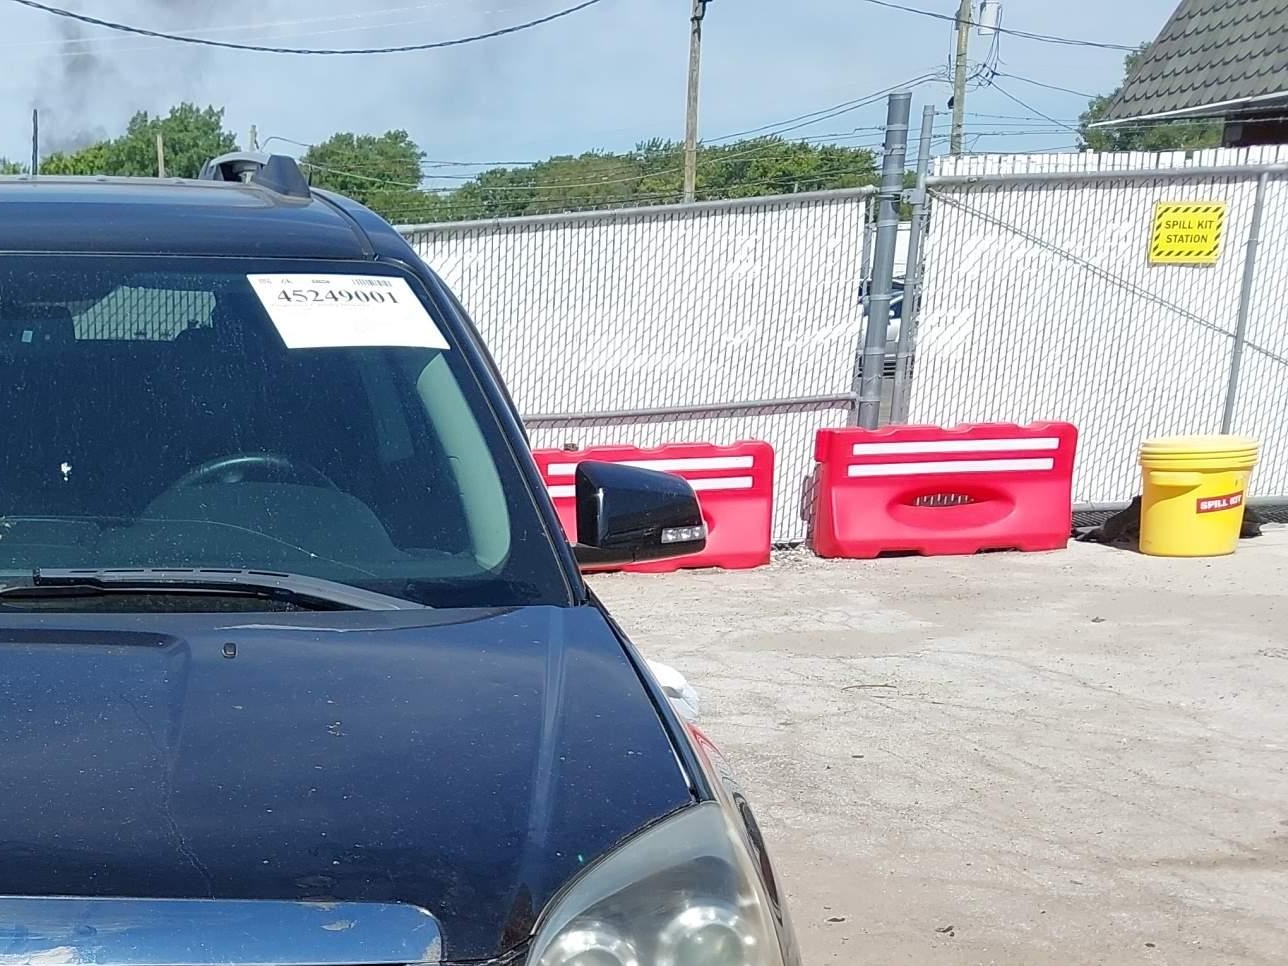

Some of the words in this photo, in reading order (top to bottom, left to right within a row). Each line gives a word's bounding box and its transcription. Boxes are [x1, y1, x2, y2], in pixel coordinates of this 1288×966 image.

[1164, 220, 1194, 230] SPILL
[1197, 220, 1215, 230] KIT
[1166, 234, 1209, 243] STATION
[277, 288, 400, 304] 45249001
[1200, 498, 1229, 510] SPILL
